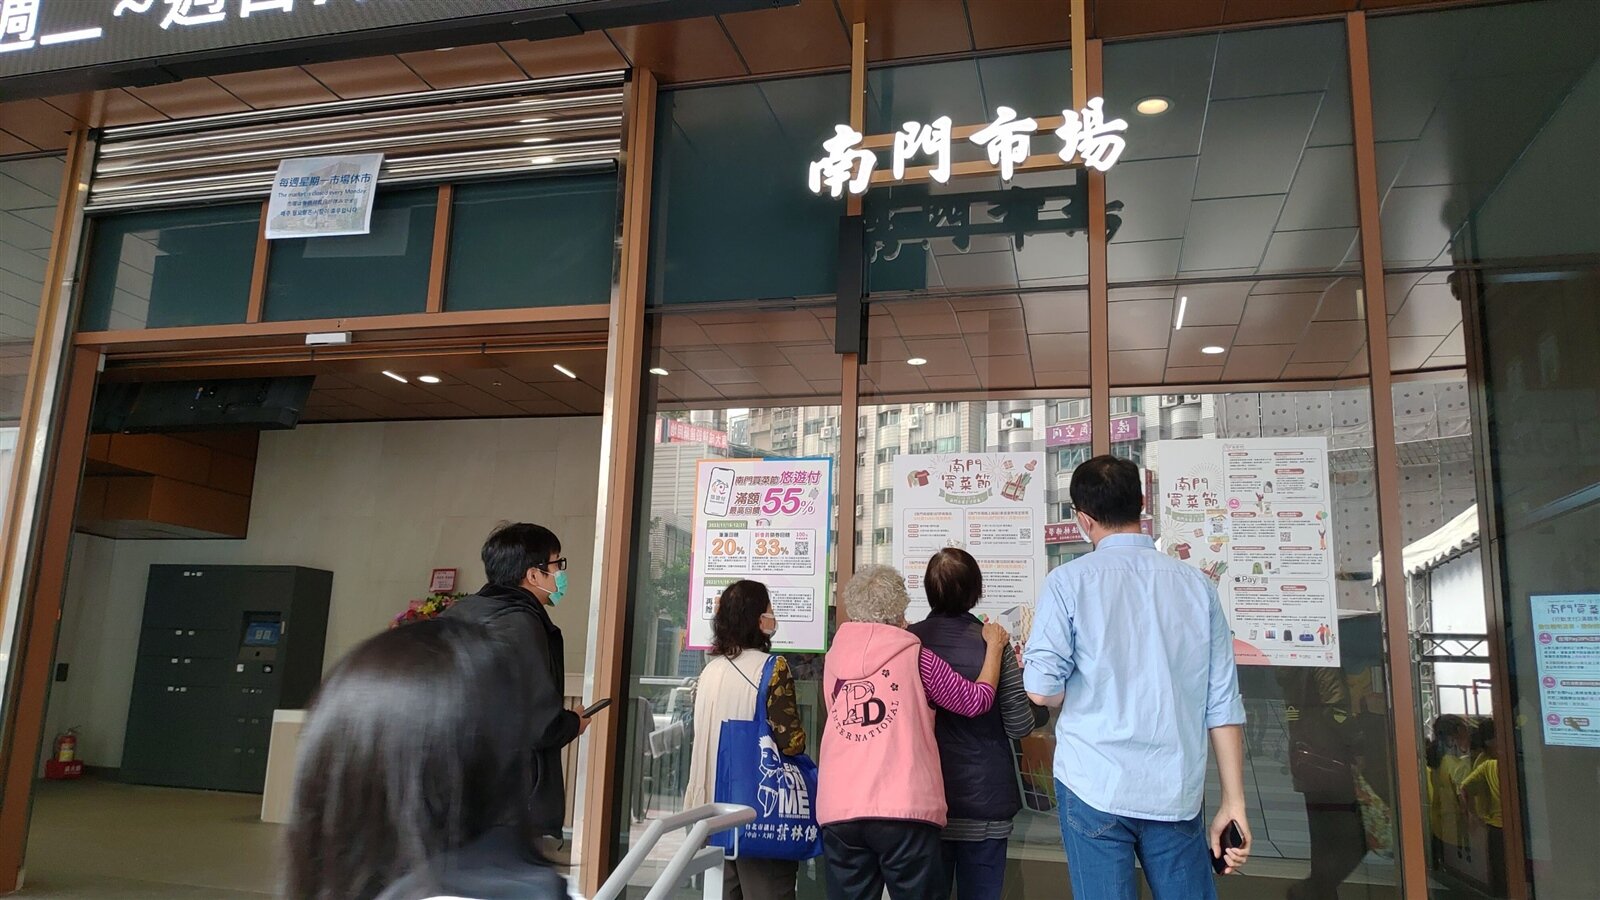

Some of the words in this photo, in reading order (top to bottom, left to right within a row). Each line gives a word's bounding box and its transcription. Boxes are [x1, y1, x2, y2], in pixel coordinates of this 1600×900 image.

[808, 96, 1128, 198] 南門市場
[279, 173, 372, 188] 每週星期一市場休市
[949, 458, 983, 473] 南門
[735, 475, 780, 487] 南門買菜節
[780, 470, 821, 486] 悠遊付
[941, 473, 991, 490] 買菜節
[1175, 476, 1209, 491] 南門
[734, 492, 761, 505] 滿額
[761, 487, 816, 516] 55%
[1167, 492, 1218, 509] 買菜節
[711, 538, 745, 557] 20%
[754, 538, 790, 557] 33%
[1241, 575, 1257, 584] Pay
[783, 771, 807, 791] ON
[778, 788, 810, 815] ME
